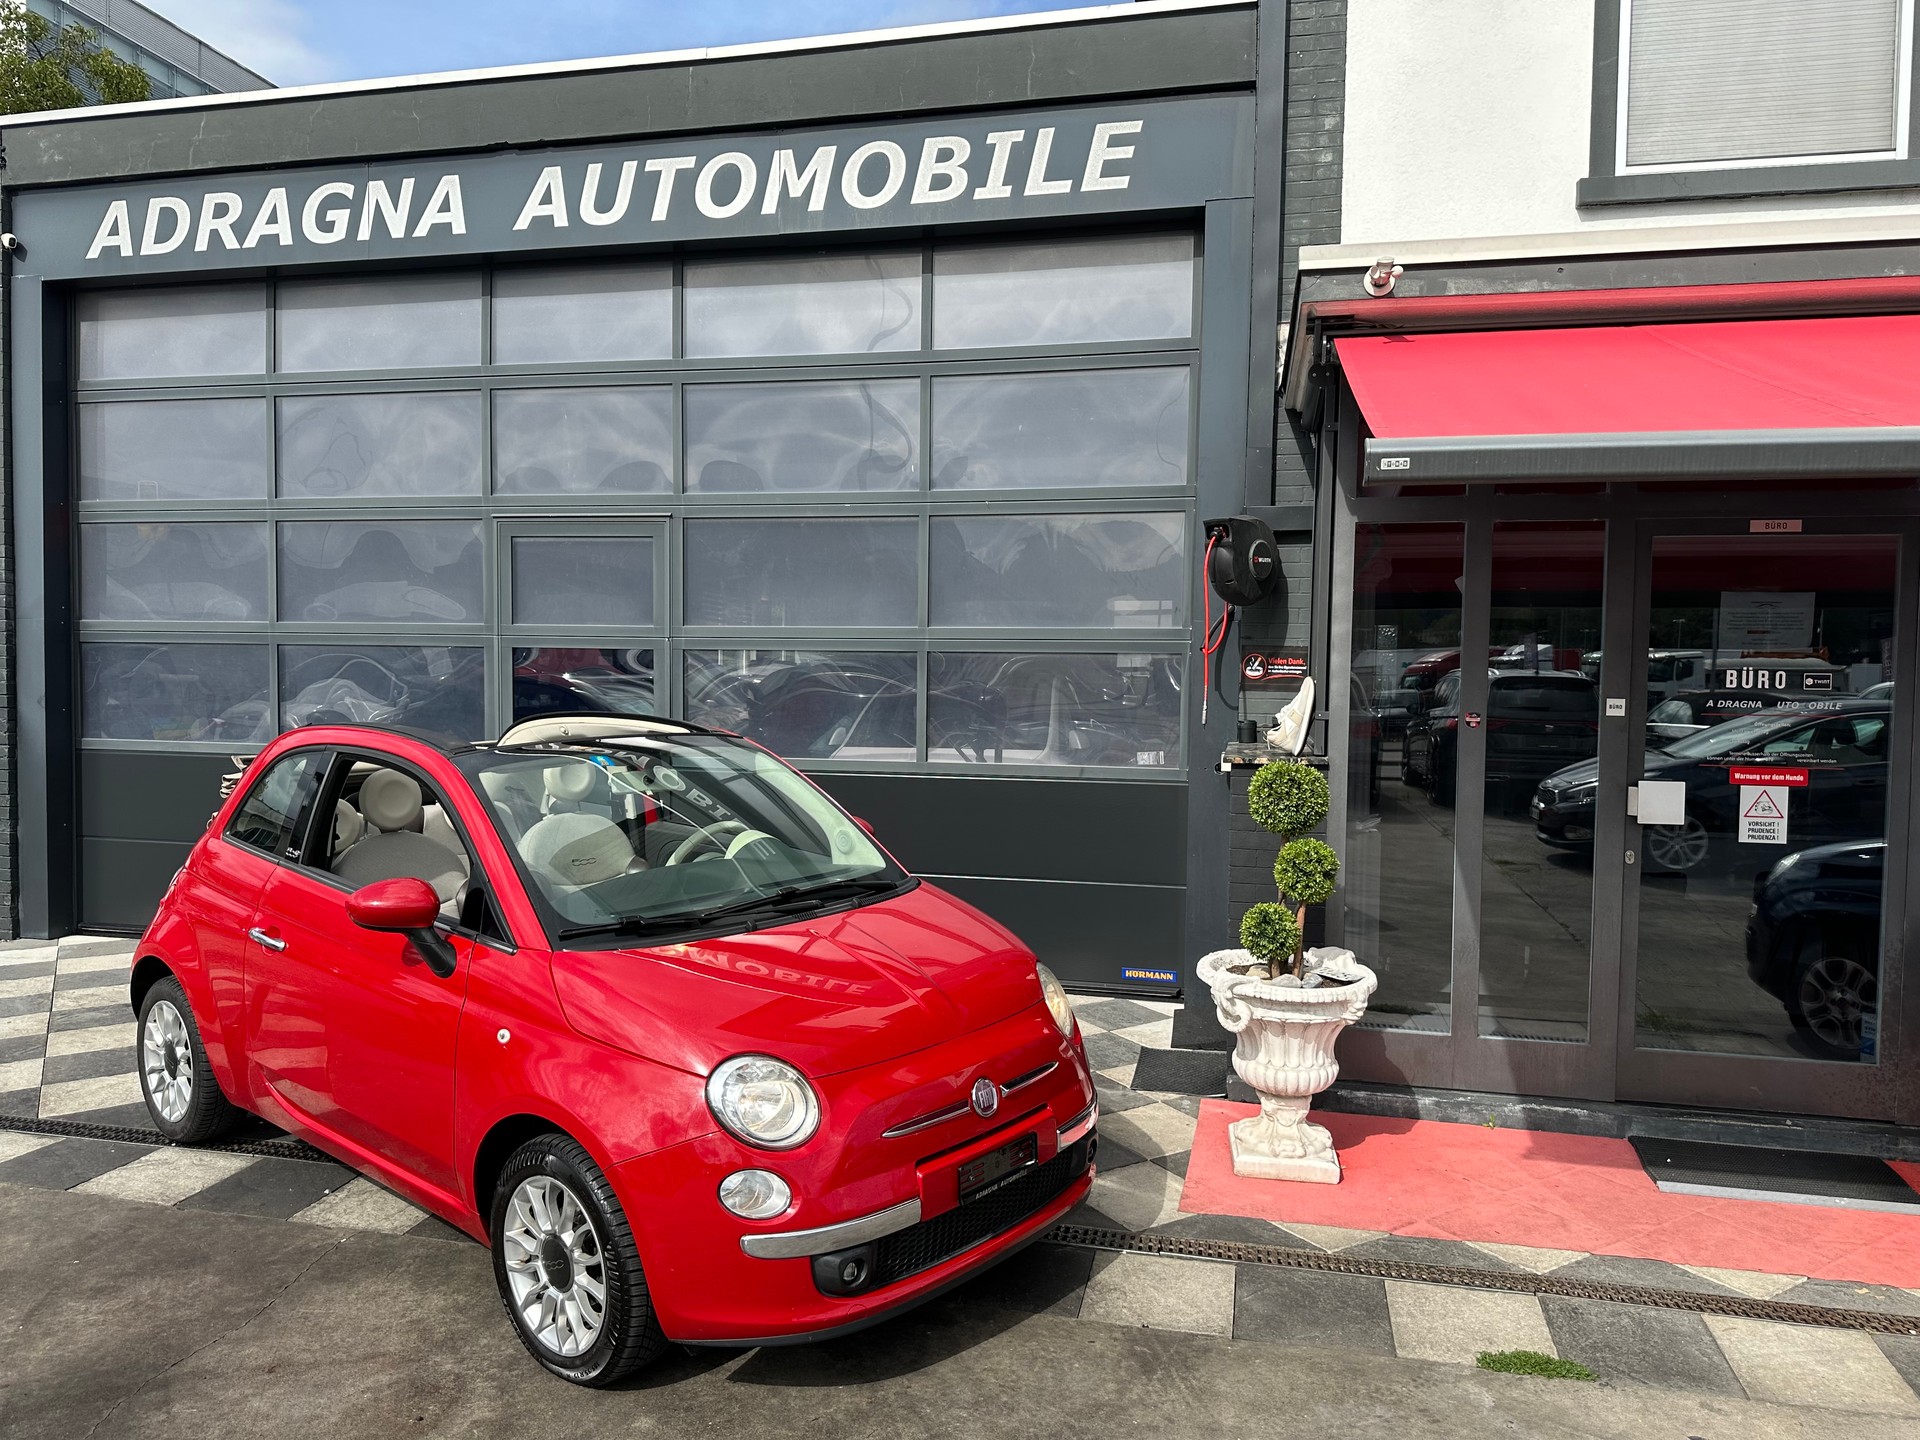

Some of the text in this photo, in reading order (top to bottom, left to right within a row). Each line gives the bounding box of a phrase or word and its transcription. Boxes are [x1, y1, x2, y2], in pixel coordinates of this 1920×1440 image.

[86, 119, 1144, 260] ADRAGNA AUTOMOBILE
[1764, 521, 1788, 530] BÜRO
[1725, 667, 1787, 689] BÜRO
[1734, 772, 1760, 781] Warnung
